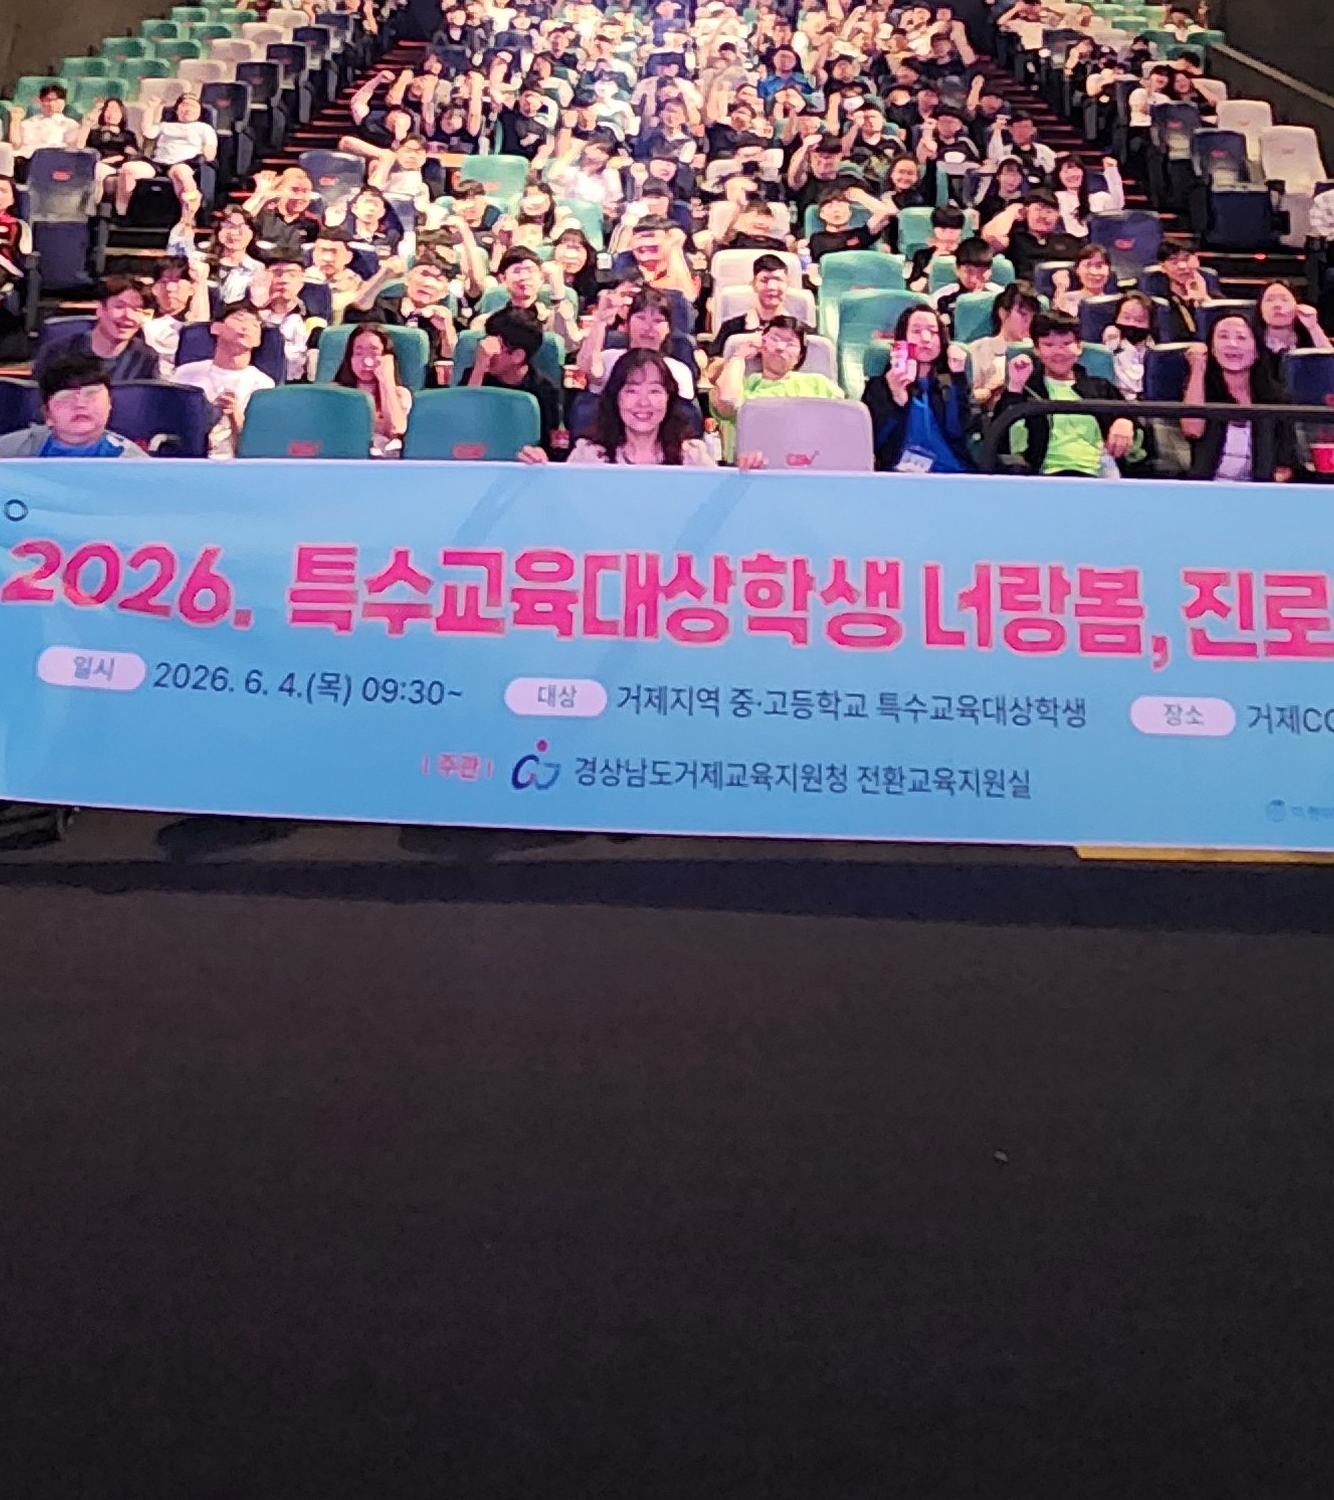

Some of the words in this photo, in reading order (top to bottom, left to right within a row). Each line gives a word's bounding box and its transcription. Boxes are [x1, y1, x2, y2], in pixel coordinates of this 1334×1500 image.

[0, 539, 253, 630] 2026.
[288, 543, 904, 649] 특수교육대상학생
[921, 562, 1170, 670] 너랑봄,
[74, 656, 116, 681] 일시
[153, 661, 234, 692] 2026.
[244, 668, 268, 696] 6.
[361, 676, 463, 706] 09:30~
[537, 685, 576, 708] 대상
[618, 685, 721, 716] 거제지역
[875, 692, 1088, 729] 특수교육대상학생
[1164, 703, 1204, 726] 장소
[575, 756, 848, 794] 경상남도거제교육지원청
[857, 764, 1032, 800] 전환교육지원실
